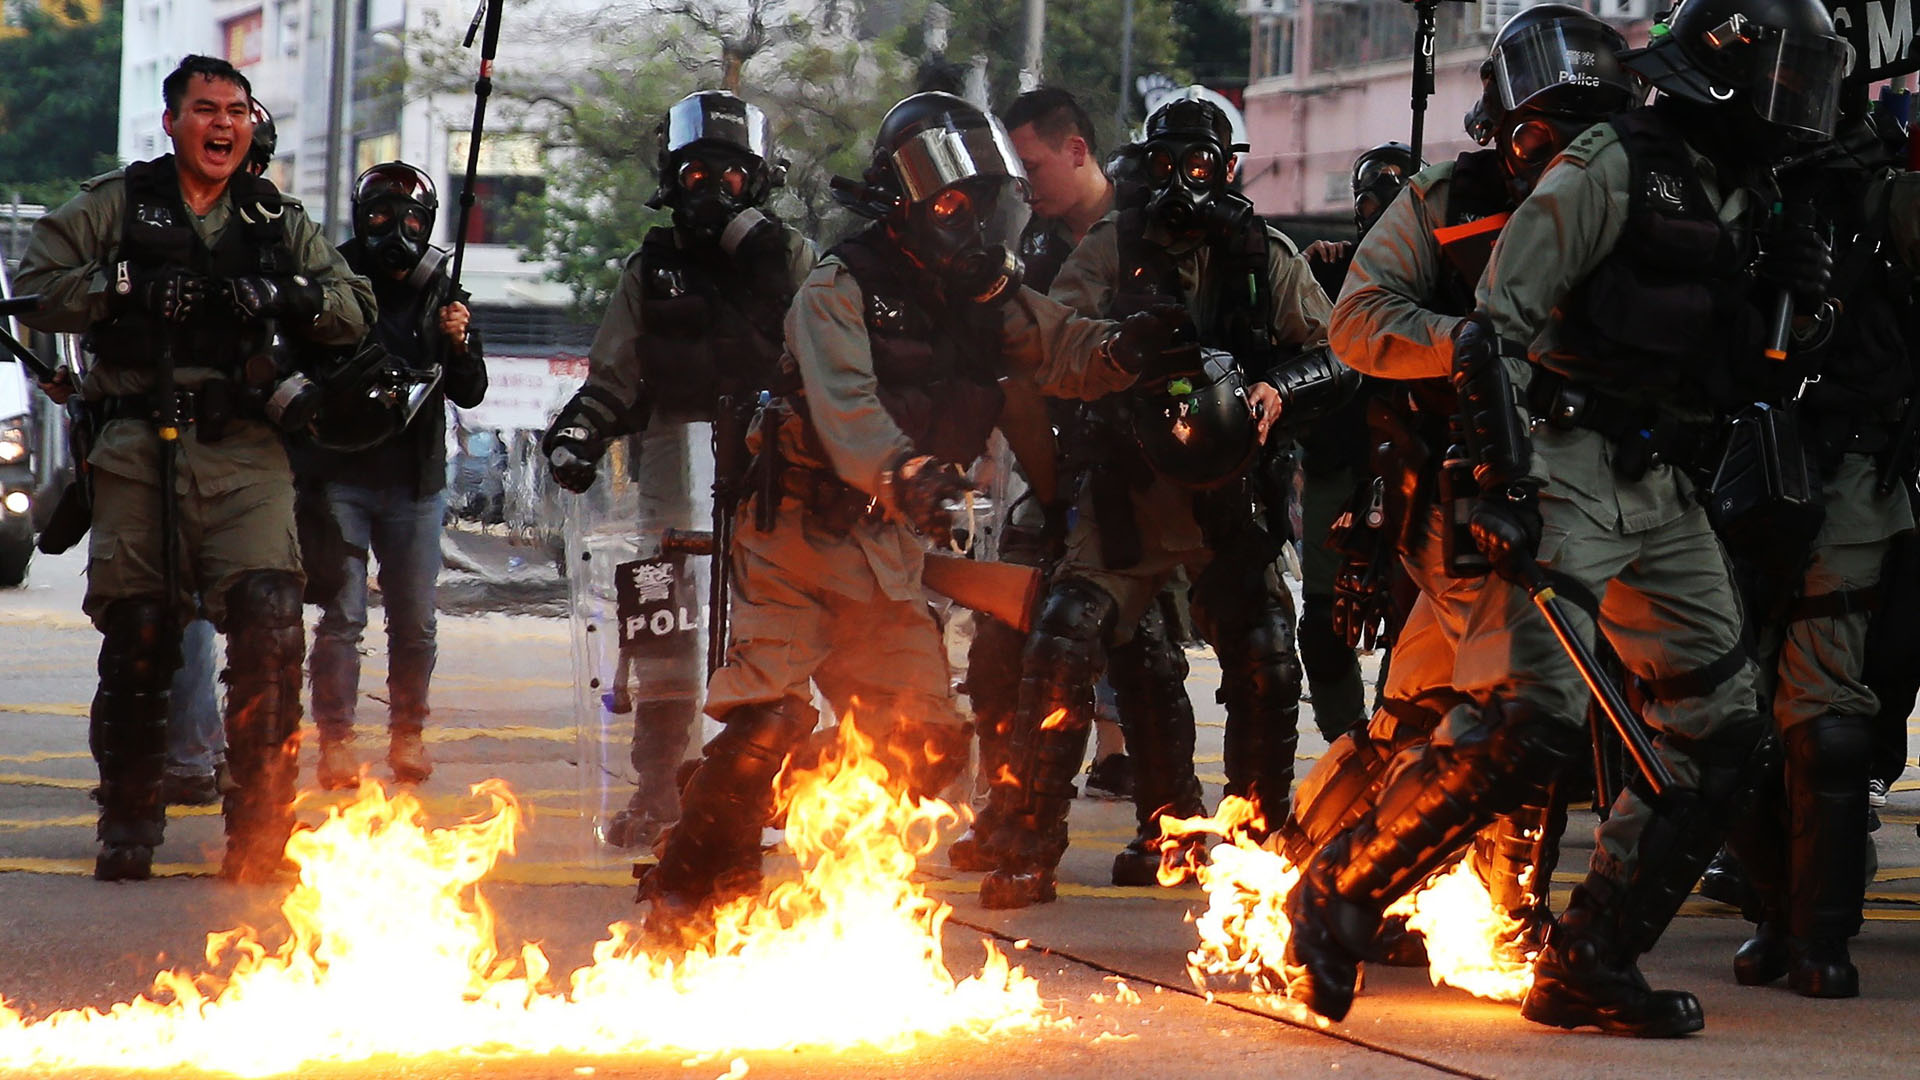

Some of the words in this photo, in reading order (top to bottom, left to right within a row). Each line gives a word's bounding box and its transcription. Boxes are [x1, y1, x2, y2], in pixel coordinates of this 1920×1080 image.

[1834, 0, 1920, 77] SM
[1566, 50, 1595, 66] 警察
[1559, 71, 1600, 86] Police
[632, 562, 674, 605] 警
